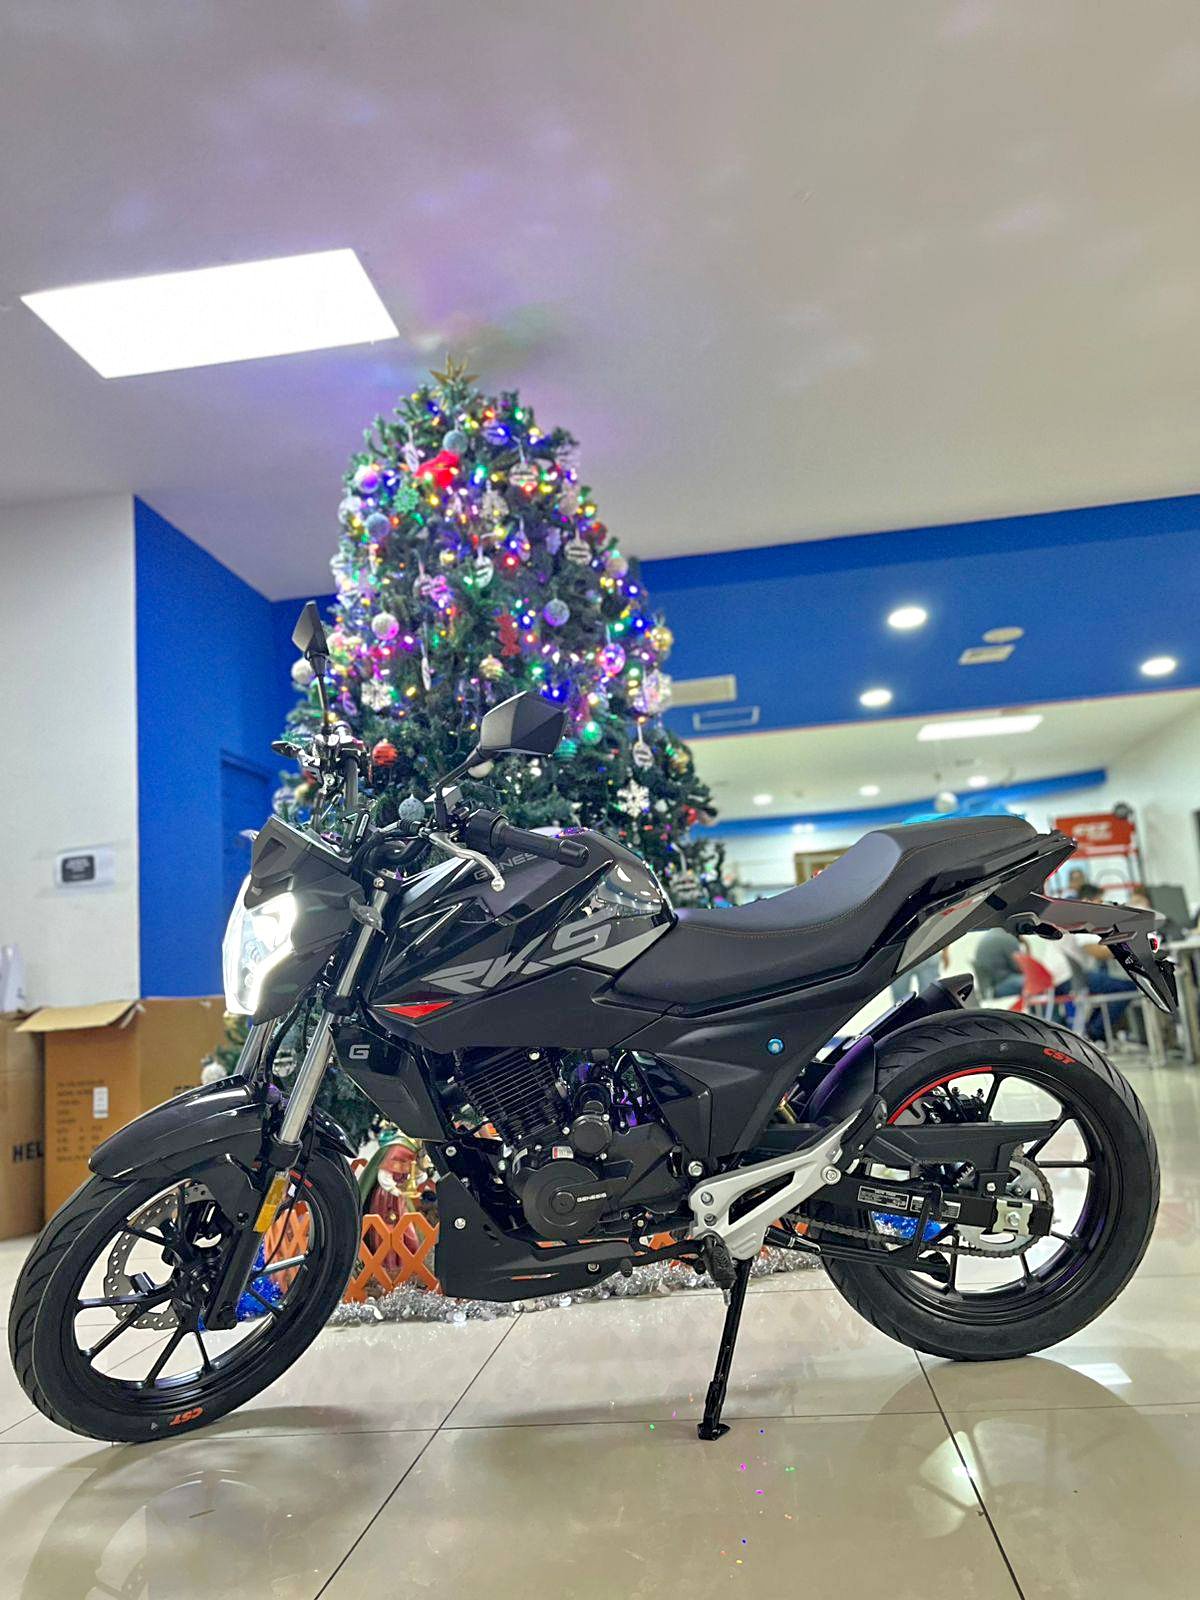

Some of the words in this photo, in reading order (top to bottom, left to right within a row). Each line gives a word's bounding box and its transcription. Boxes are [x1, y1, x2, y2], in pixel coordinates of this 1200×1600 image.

[473, 852, 539, 880] GNES
[420, 903, 619, 995] RKS
[349, 1044, 370, 1060] G
[1043, 1047, 1077, 1065] CST
[169, 1407, 204, 1426] CST
